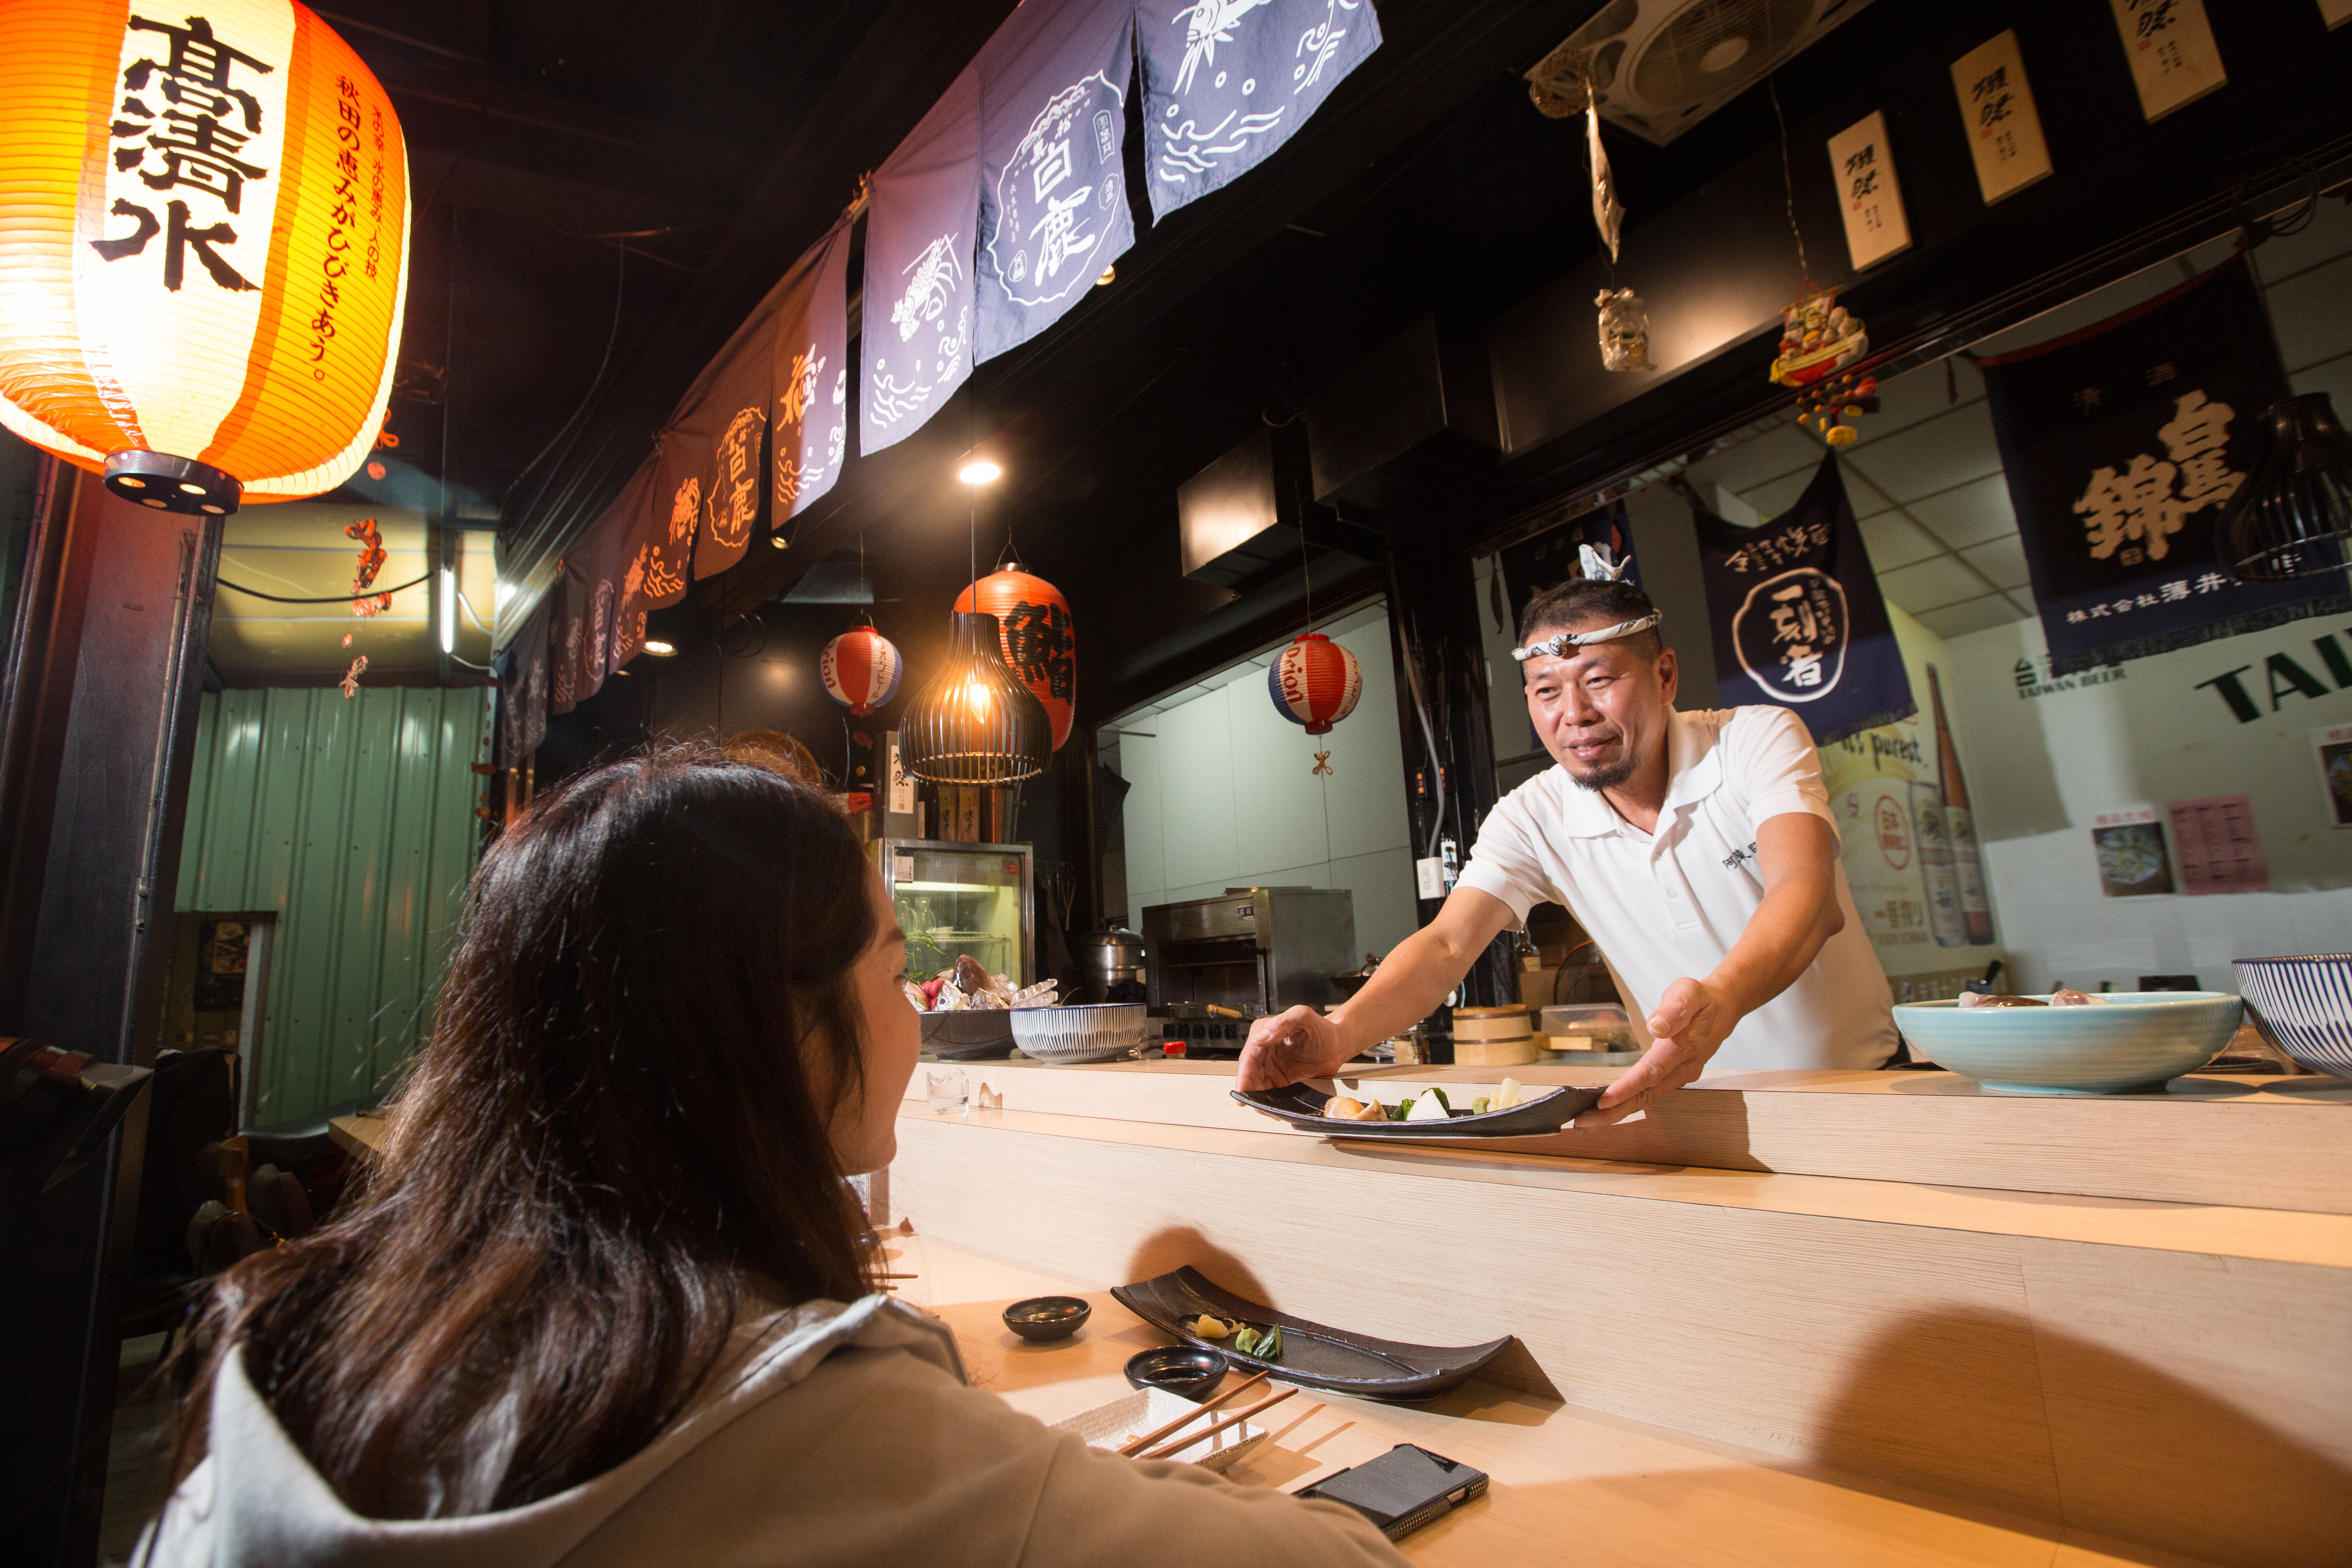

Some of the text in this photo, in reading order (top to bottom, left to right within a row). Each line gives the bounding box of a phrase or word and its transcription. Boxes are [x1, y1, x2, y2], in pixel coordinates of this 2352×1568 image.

[2128, 0, 2180, 38] 祭
[1028, 138, 1095, 286] 白鹿
[729, 442, 755, 535] 白鹿
[1003, 600, 1074, 707] 鮨
[1283, 646, 1304, 704] Orion
[2192, 627, 2352, 724] TAI
